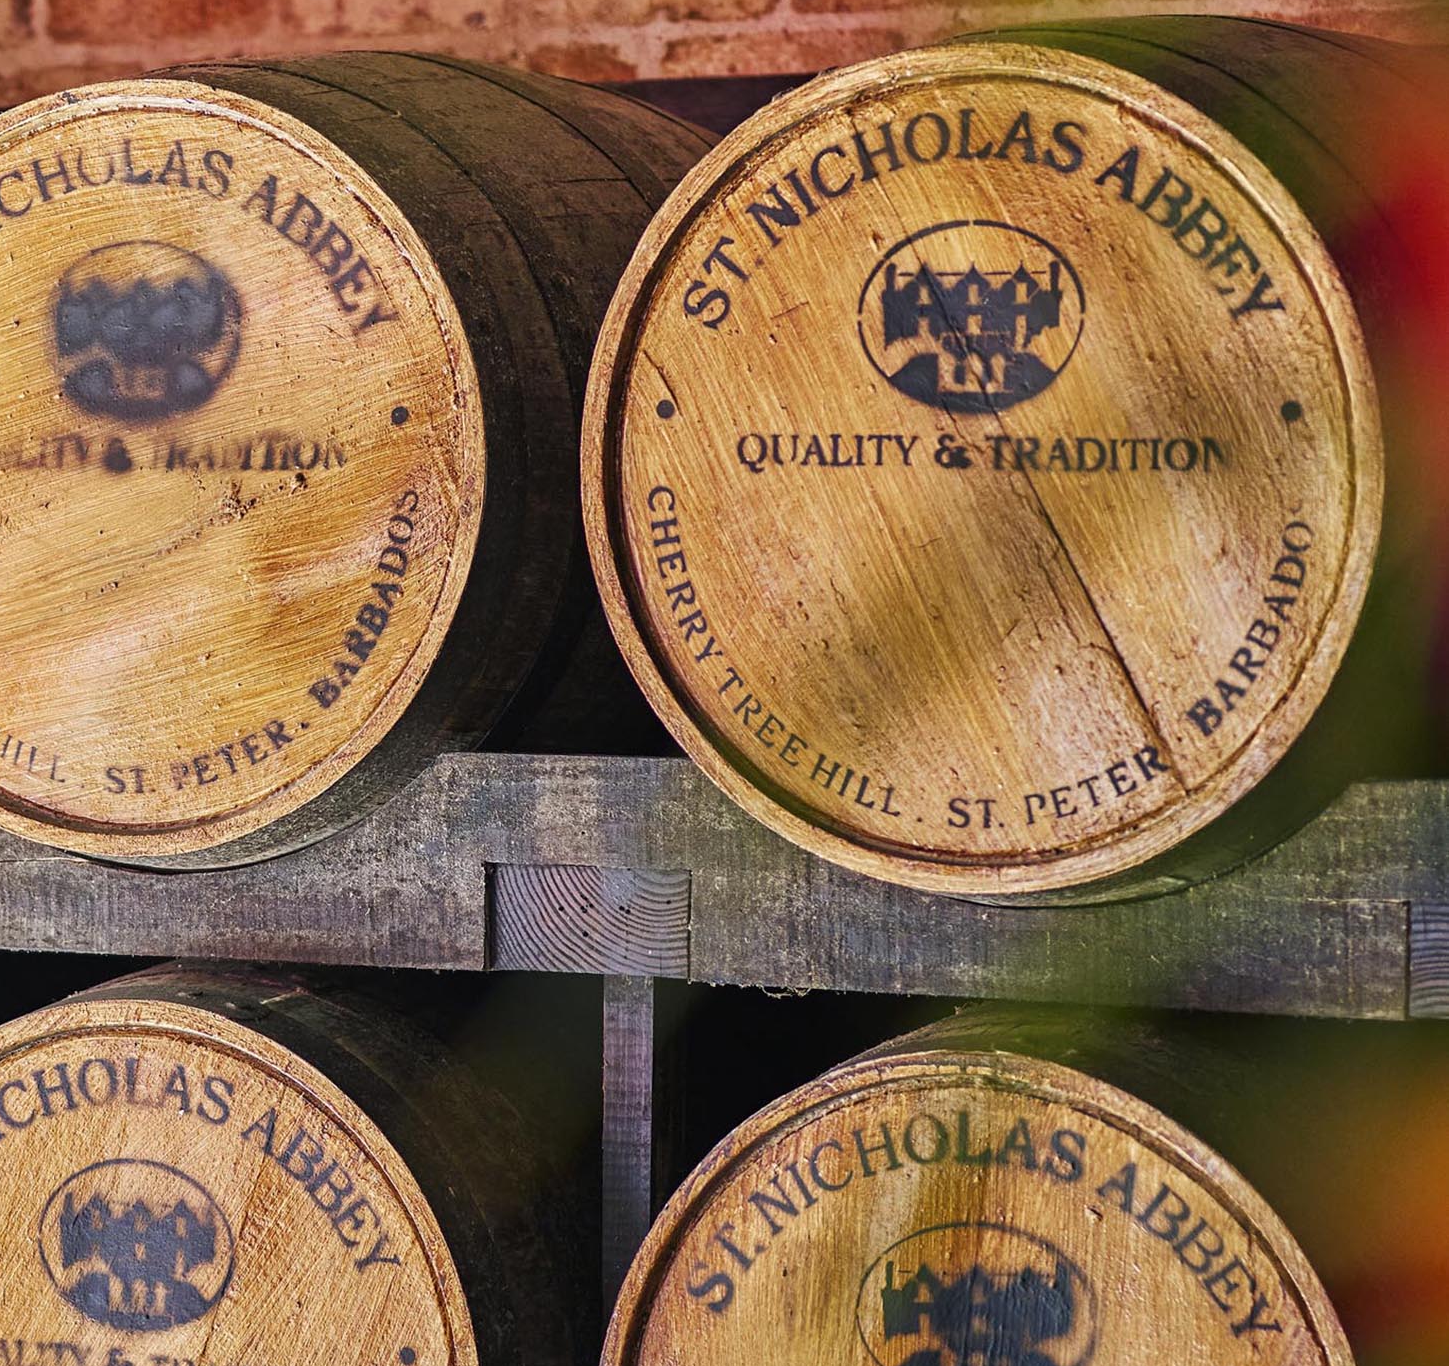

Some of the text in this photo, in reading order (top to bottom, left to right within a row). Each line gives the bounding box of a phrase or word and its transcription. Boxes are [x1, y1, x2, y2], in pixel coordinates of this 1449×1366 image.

[245, 173, 398, 336] ABBEY
[746, 109, 1088, 248] NICHOLAS
[1095, 148, 1285, 325] ABBEY
[150, 438, 349, 473] RADITION
[737, 432, 1231, 474] QUALITY & TRADITION
[309, 490, 420, 709] BARBADOS
[647, 484, 1314, 830] CHERRY TREE HILL ST. PETER BARBADO
[243, 1109, 401, 1273] ABBEY
[686, 1109, 1283, 1356] ST. NICHOLAS ABBEY
